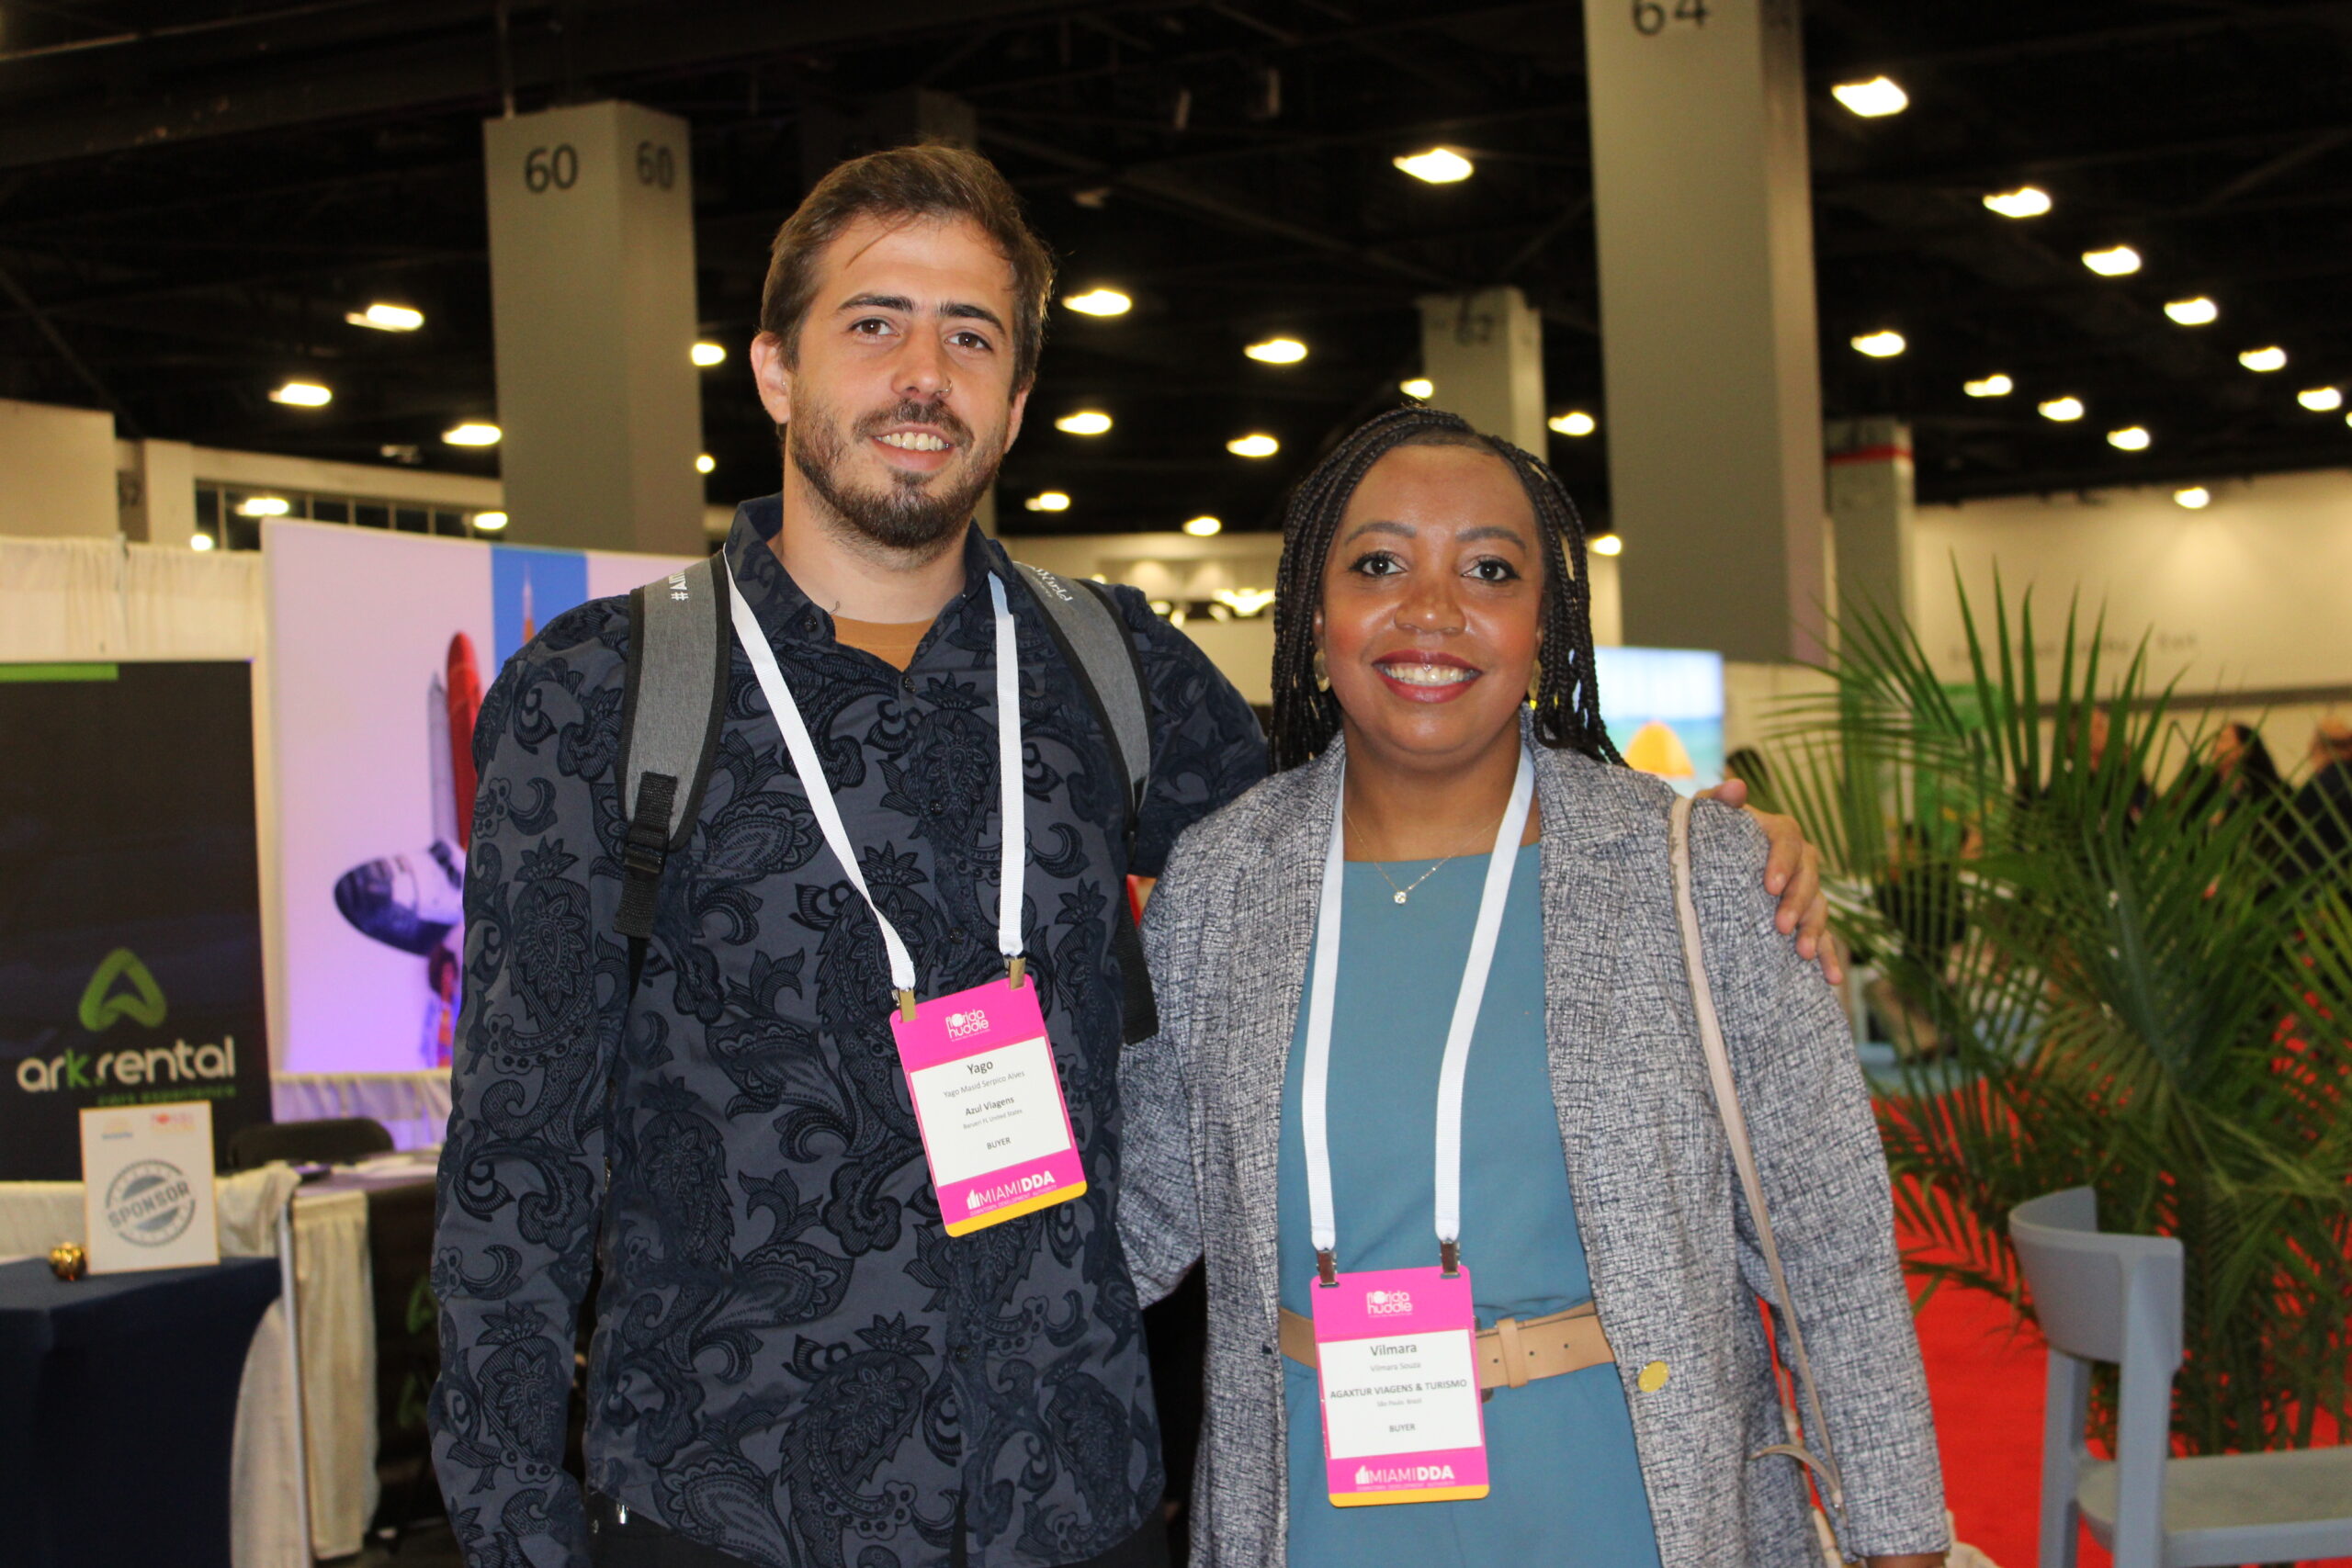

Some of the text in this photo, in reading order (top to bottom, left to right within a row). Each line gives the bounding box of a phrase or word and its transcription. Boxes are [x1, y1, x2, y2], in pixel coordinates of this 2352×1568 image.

[524, 142, 579, 194] 60
[637, 140, 676, 192] 60
[947, 1017, 989, 1039] huddle
[967, 1061, 994, 1075] Yago
[943, 1089, 960, 1098] Yago
[981, 1076, 1007, 1088] Serpico
[1007, 1070, 1025, 1080] Alves
[965, 1096, 1014, 1116] Azul Viagens
[987, 1136, 1012, 1150] BUYER
[107, 1180, 190, 1229] SPONSOR
[1370, 1344, 1418, 1357] Vilmara
[1370, 1361, 1421, 1372] Vilmara Souza
[1330, 1379, 1467, 1399] AGAXTUR VIAGENS & TURISMO
[1389, 1423, 1416, 1433] BUYER
